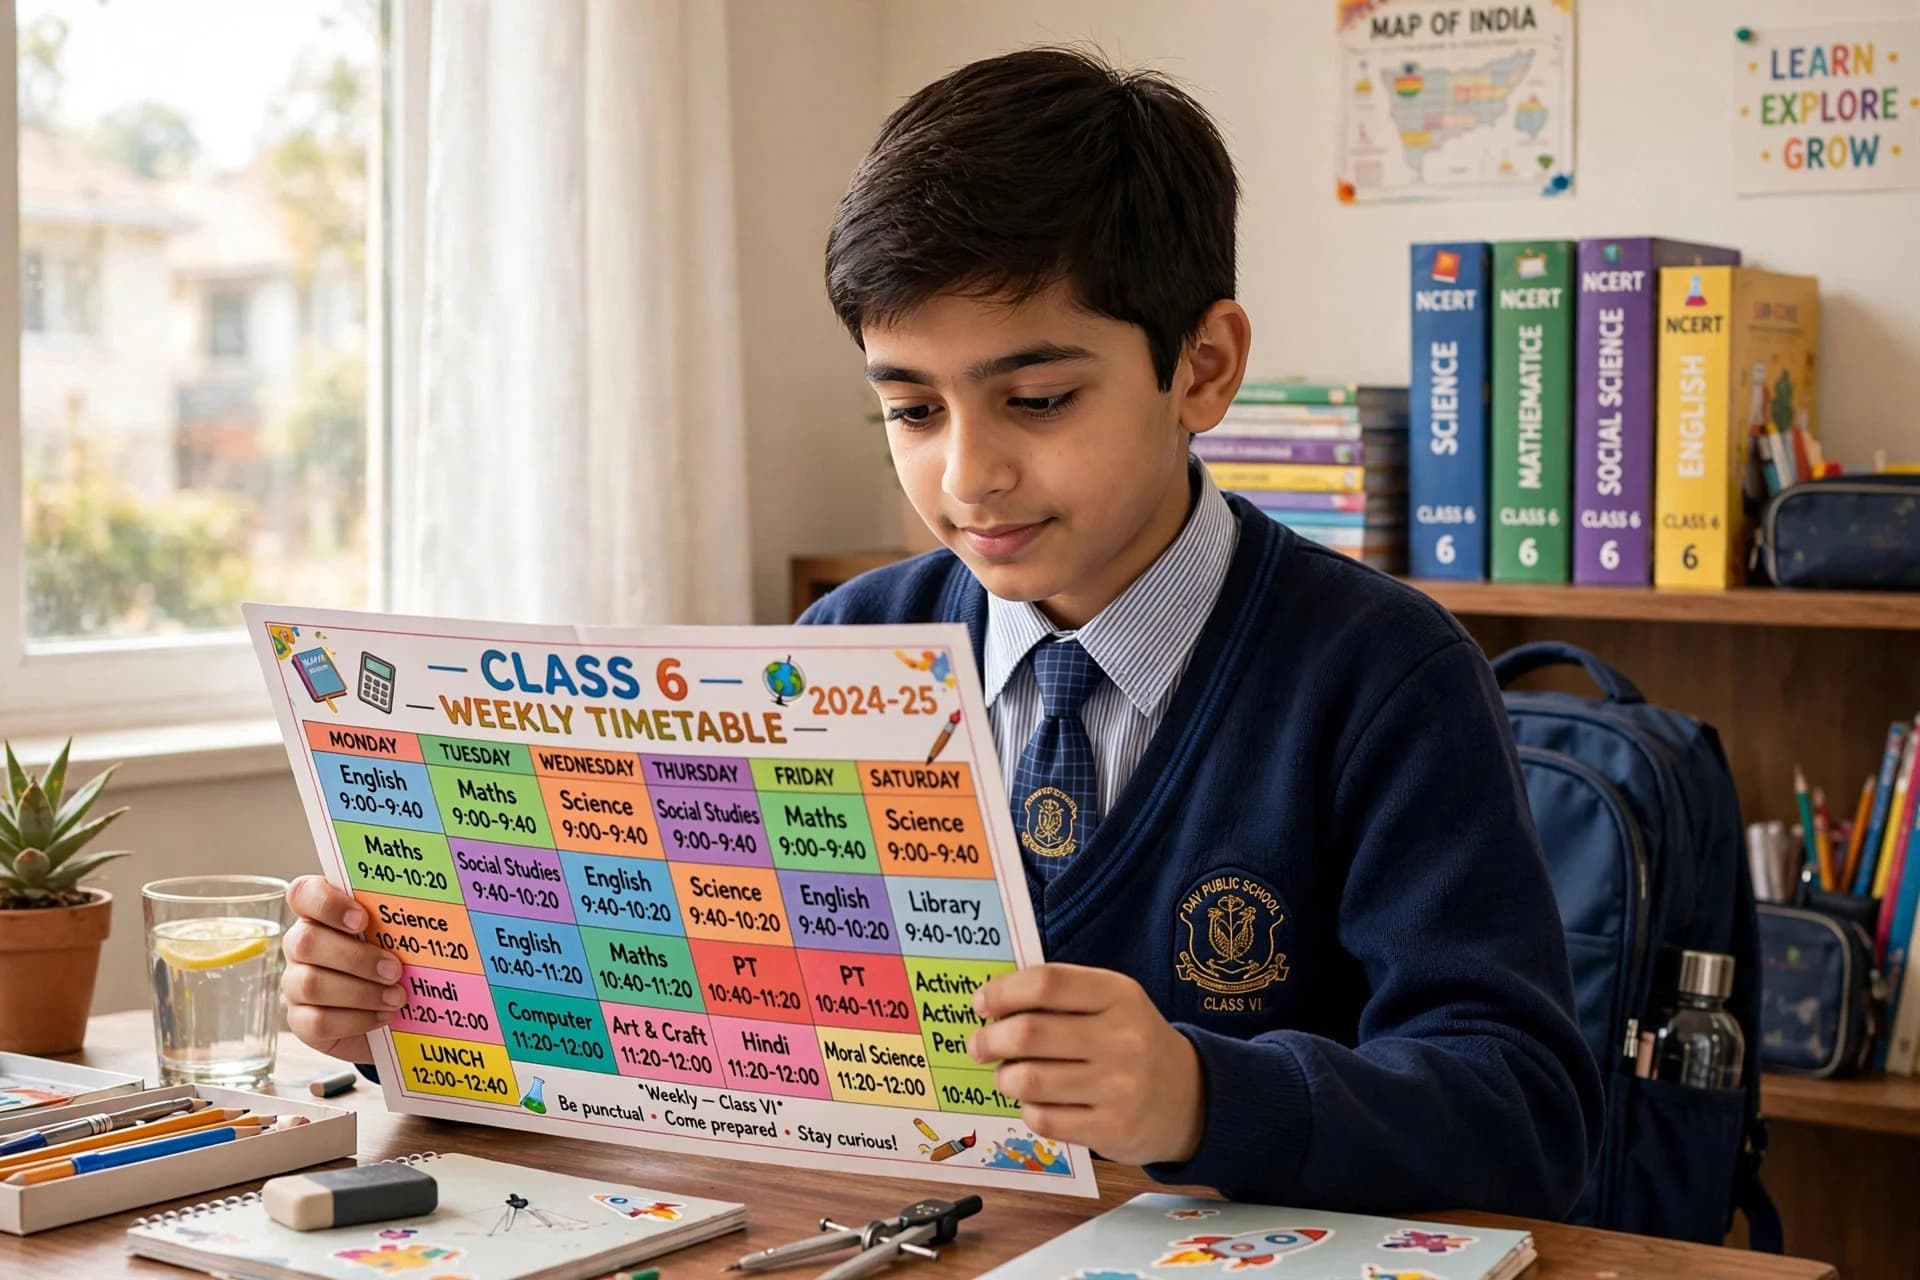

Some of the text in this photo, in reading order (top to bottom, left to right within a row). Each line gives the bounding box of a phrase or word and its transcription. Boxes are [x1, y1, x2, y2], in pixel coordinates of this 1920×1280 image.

[1370, 6, 1537, 39] MAP OF INDIA
[1771, 42, 1876, 81] LEARN
[1761, 87, 1899, 126] EXPLORE
[1783, 133, 1880, 171] GROW
[1582, 271, 1645, 292] NCERT
[1416, 289, 1477, 311] NCERT
[1500, 287, 1562, 309] NCERT
[1665, 315, 1724, 334] NCERT
[1430, 341, 1458, 456] SCIENCE
[1597, 307, 1624, 496] SOCIAL SCIENCE
[1677, 354, 1705, 478] ENGLISH
[1416, 506, 1461, 524] CLASS
[1500, 507, 1546, 526] CLASS
[1581, 510, 1627, 529] CLASS
[1435, 534, 1456, 565] 6
[1518, 537, 1539, 567] 6
[1600, 540, 1620, 570] 6
[1682, 544, 1698, 569] 6
[480, 649, 689, 702] CLASS 6
[808, 685, 938, 716] 2024-25
[438, 694, 788, 744] WEEKLY TIMETABLE
[329, 730, 397, 754] MONDAY
[438, 742, 510, 767] TUESDAY
[339, 764, 408, 793] English
[538, 753, 634, 777] WEDNESDAY
[651, 761, 738, 783] THURSDAY
[774, 766, 834, 786] FRIDAY
[870, 768, 960, 789] SATURDAY
[339, 791, 424, 819] 9:00-9:40
[457, 778, 518, 805] Maths
[559, 789, 634, 817] Science
[452, 806, 537, 835] 9:00-9:40
[656, 798, 761, 825] Social Studies
[784, 804, 848, 829] Maths
[885, 808, 965, 833] Science
[562, 819, 648, 846] 9:00-9:40
[672, 829, 757, 854] 9:00-9:40
[364, 834, 424, 861] Maths
[778, 836, 867, 860] 9:00-9:40
[887, 841, 979, 864] 9:00-9:40
[357, 861, 448, 893] 9:40-10:20
[456, 851, 561, 883] Social Studies
[583, 865, 652, 895] English
[472, 880, 560, 910] 9:40-10:20
[689, 875, 762, 902] Science
[799, 884, 870, 914] English
[1201, 876, 1240, 897] PUBLIC
[1241, 879, 1281, 916] SCHOOL
[378, 904, 449, 932] Science
[580, 894, 672, 923] 9:40-10:20
[689, 906, 781, 933] 9:40-10:20
[908, 890, 981, 921] Library
[798, 914, 890, 941] 9:40-10:20
[904, 922, 1001, 946] 9:40-10:20
[375, 931, 469, 961] 10:40-11:20
[495, 927, 563, 957] English
[609, 941, 669, 969] Maths
[488, 955, 583, 985] 10:40-11:20
[732, 955, 757, 978] PT
[839, 964, 865, 987] PT
[409, 976, 459, 1002] Hindi
[599, 971, 693, 1000] 10:40-11:20
[708, 983, 801, 1010] 10:40-11:20
[400, 1003, 489, 1031] 11:20-12:00
[507, 1001, 593, 1031] Computer
[815, 994, 910, 1020] 10:40-11:20
[1203, 996, 1262, 1013] CLASS VI
[512, 1029, 604, 1060] 11:20-12:00
[612, 1015, 708, 1047] Art & Craft
[741, 1030, 791, 1056] Hindi
[932, 1031, 967, 1054] Peri
[420, 1043, 486, 1070] LUNCH
[620, 1045, 713, 1074] 11:20-12:00
[823, 1040, 926, 1069] Moral Science
[411, 1065, 508, 1096] 12:00-12:40
[727, 1058, 820, 1086] 11:20-12:00
[837, 1071, 926, 1097] 11:20-12:00
[718, 1094, 758, 1113] Class
[942, 1085, 1021, 1109] 10:40-11:2
[557, 1094, 898, 1152] Be punctual Come prepared Stay curious!
